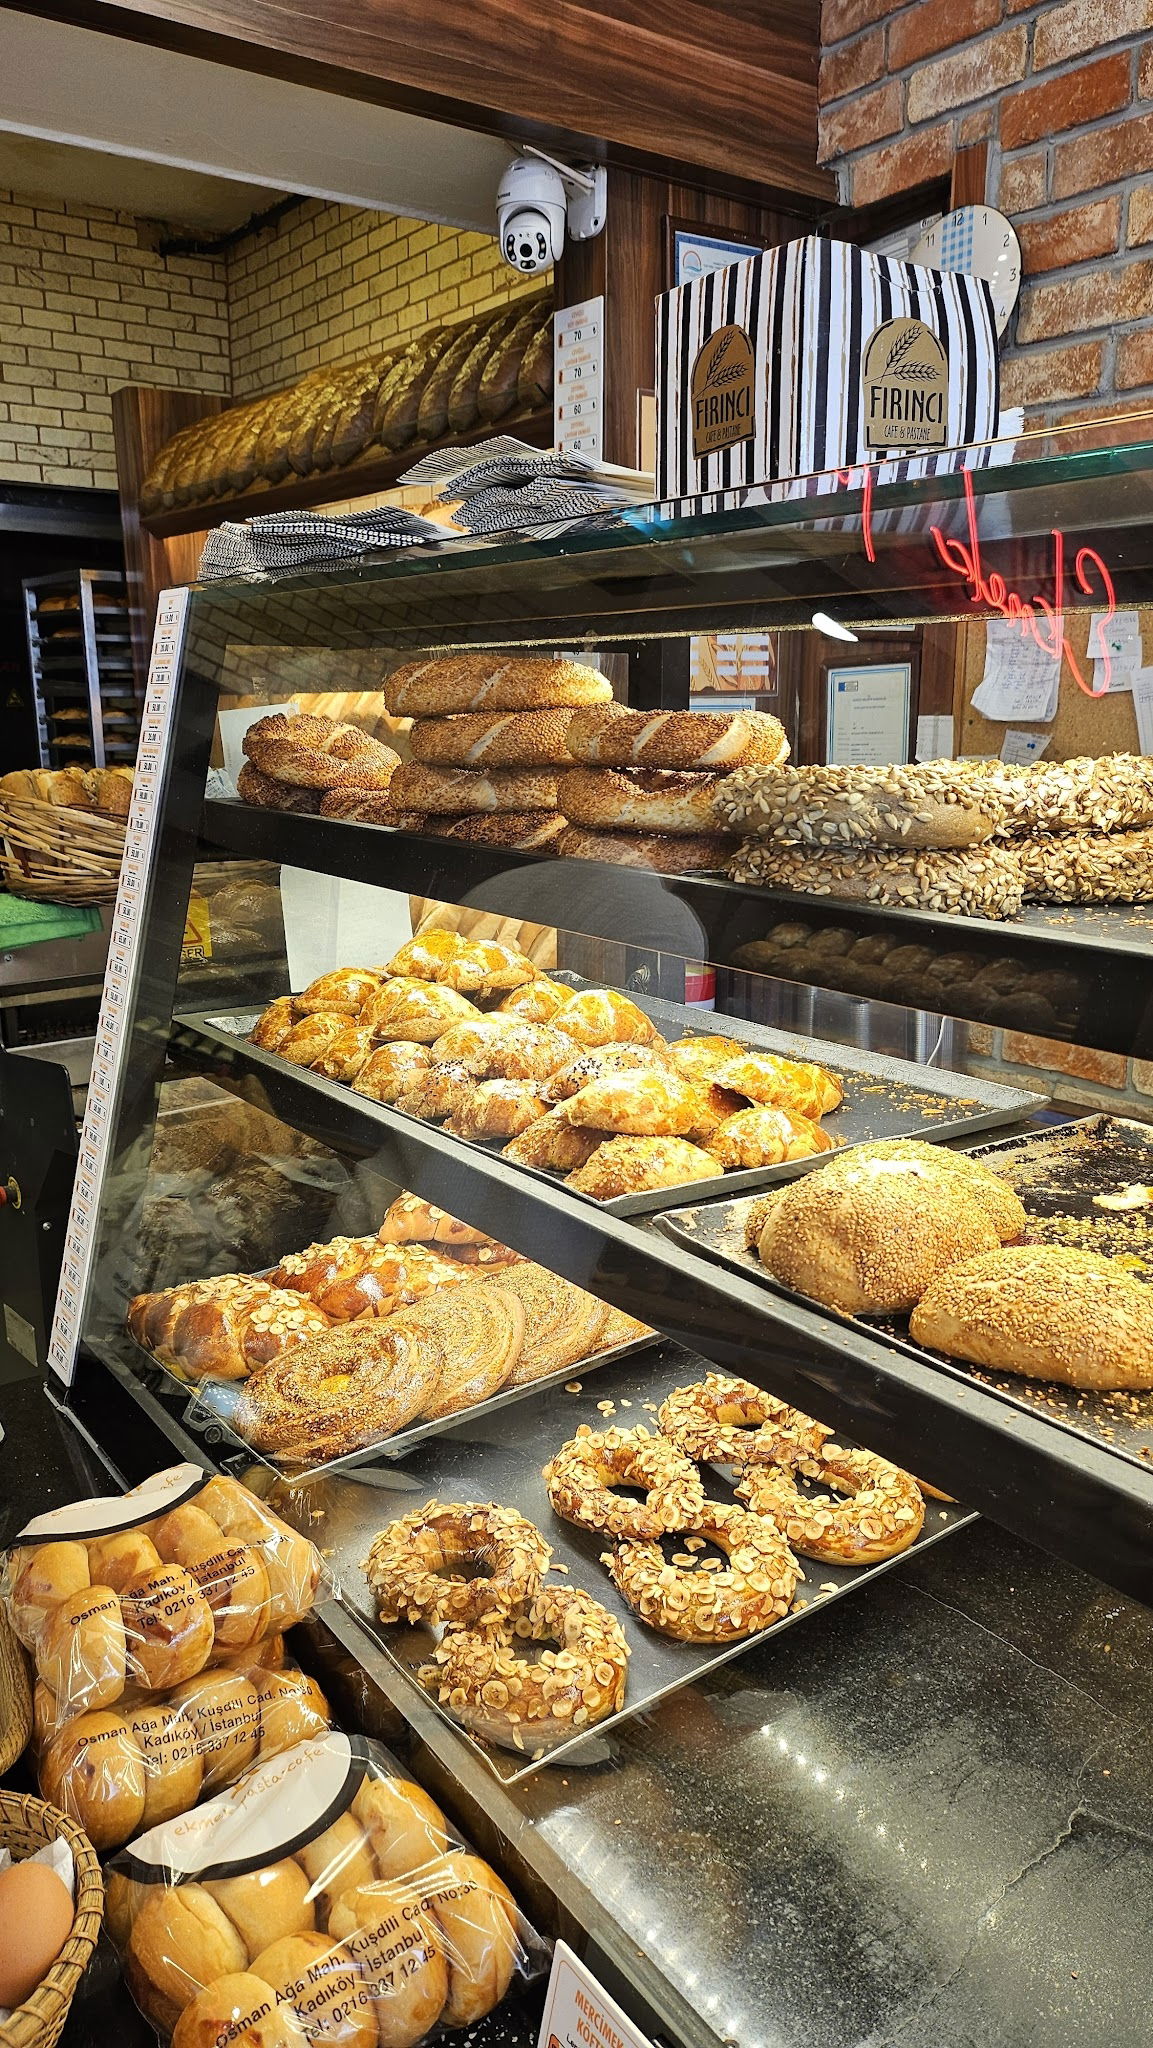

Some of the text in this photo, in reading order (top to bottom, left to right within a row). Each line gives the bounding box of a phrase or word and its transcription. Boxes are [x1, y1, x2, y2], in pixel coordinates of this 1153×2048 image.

[953, 212, 964, 228] 12
[982, 212, 987, 226] 1
[926, 233, 935, 248] 11
[1003, 233, 1010, 248] 2
[1010, 267, 1017, 281] 3
[1000, 306, 1007, 317] 4
[574, 330, 582, 341] 70
[574, 368, 582, 379] 70
[696, 385, 751, 431] FIRINCI
[870, 385, 943, 424] FIRINCI
[705, 427, 716, 444] CAFE
[884, 425, 930, 441] CAFE & PASTANE
[70, 1599, 117, 1626] Osman
[147, 1574, 180, 1592] Mah.
[181, 1553, 226, 1576] Kuşdili
[134, 1556, 246, 1613] Kadıköy / İstanbul
[136, 1612, 162, 1631] Tel:
[164, 1594, 196, 1617] 0216
[240, 1565, 256, 1580] 45
[78, 1726, 127, 1747] Osman
[131, 1718, 158, 1734] Ağa
[197, 1698, 243, 1719] Kuşdili
[247, 1689, 276, 1705] Cad.
[144, 1710, 262, 1749] Kadıköy / İstanbul
[172, 1743, 203, 1760] 0216
[232, 1731, 248, 1743] 12
[215, 2001, 271, 2048] Osman
[274, 1979, 306, 2004] Ağa
[306, 1955, 346, 1983] Mah.
[346, 1919, 400, 1954] Kuşdili
[402, 1898, 435, 1922] Cad.
[294, 1975, 357, 2021] Kadıköy
[300, 2017, 331, 2048] Tel:
[332, 1990, 369, 2023] 0216
[400, 1961, 418, 1980] 12
